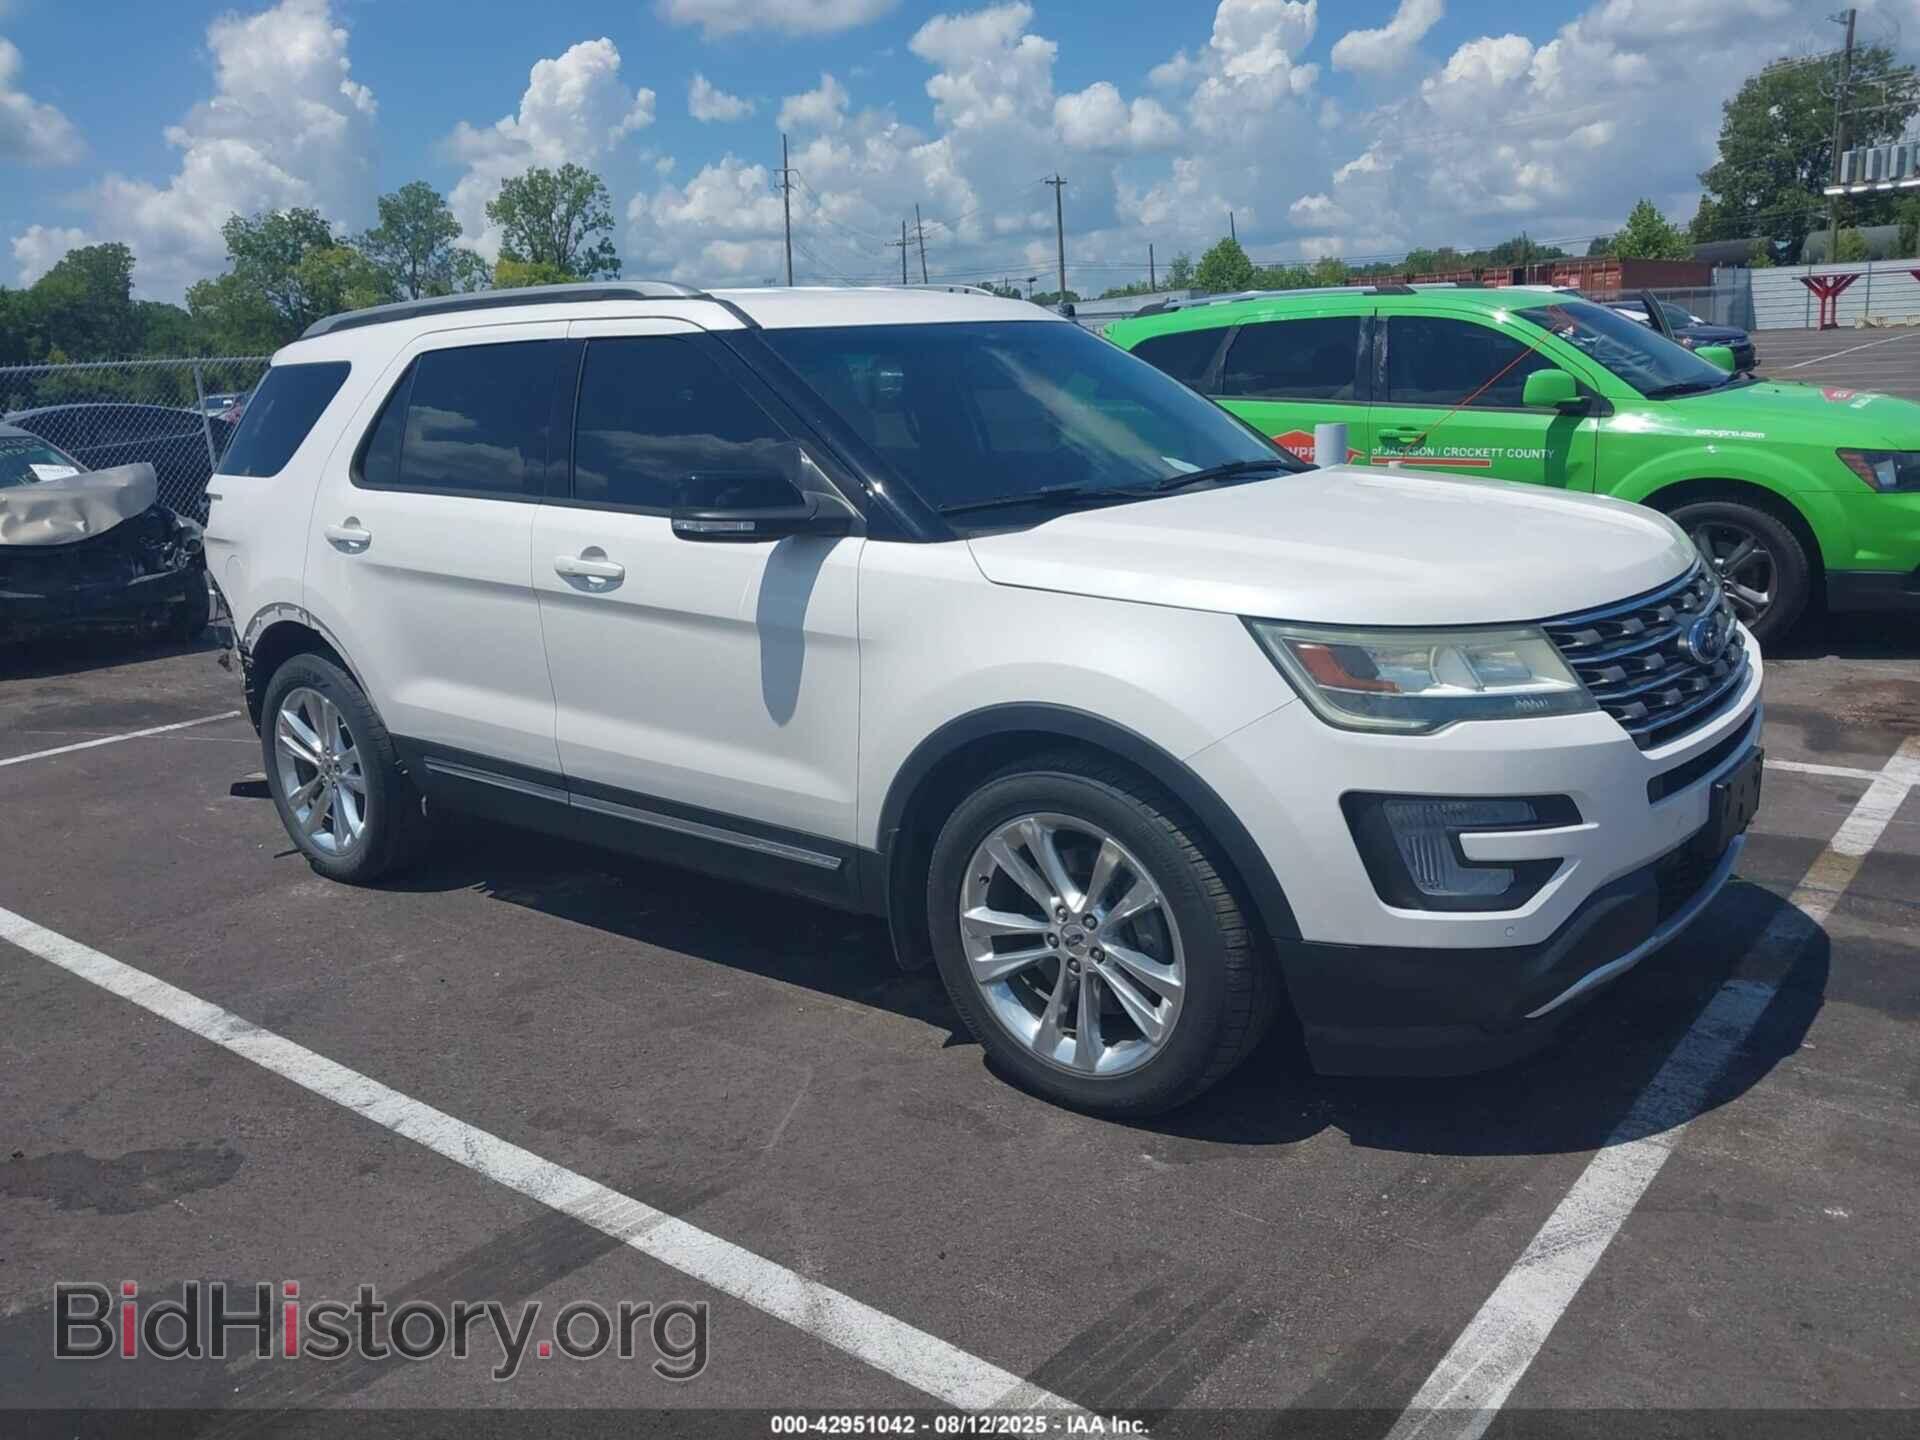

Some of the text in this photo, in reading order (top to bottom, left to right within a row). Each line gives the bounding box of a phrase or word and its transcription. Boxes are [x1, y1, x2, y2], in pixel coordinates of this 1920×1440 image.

[1372, 446, 1382, 456] of
[1384, 446, 1434, 457] JACKSON
[1443, 447, 1504, 458] CROCKETT
[1507, 448, 1555, 459] COUNTY
